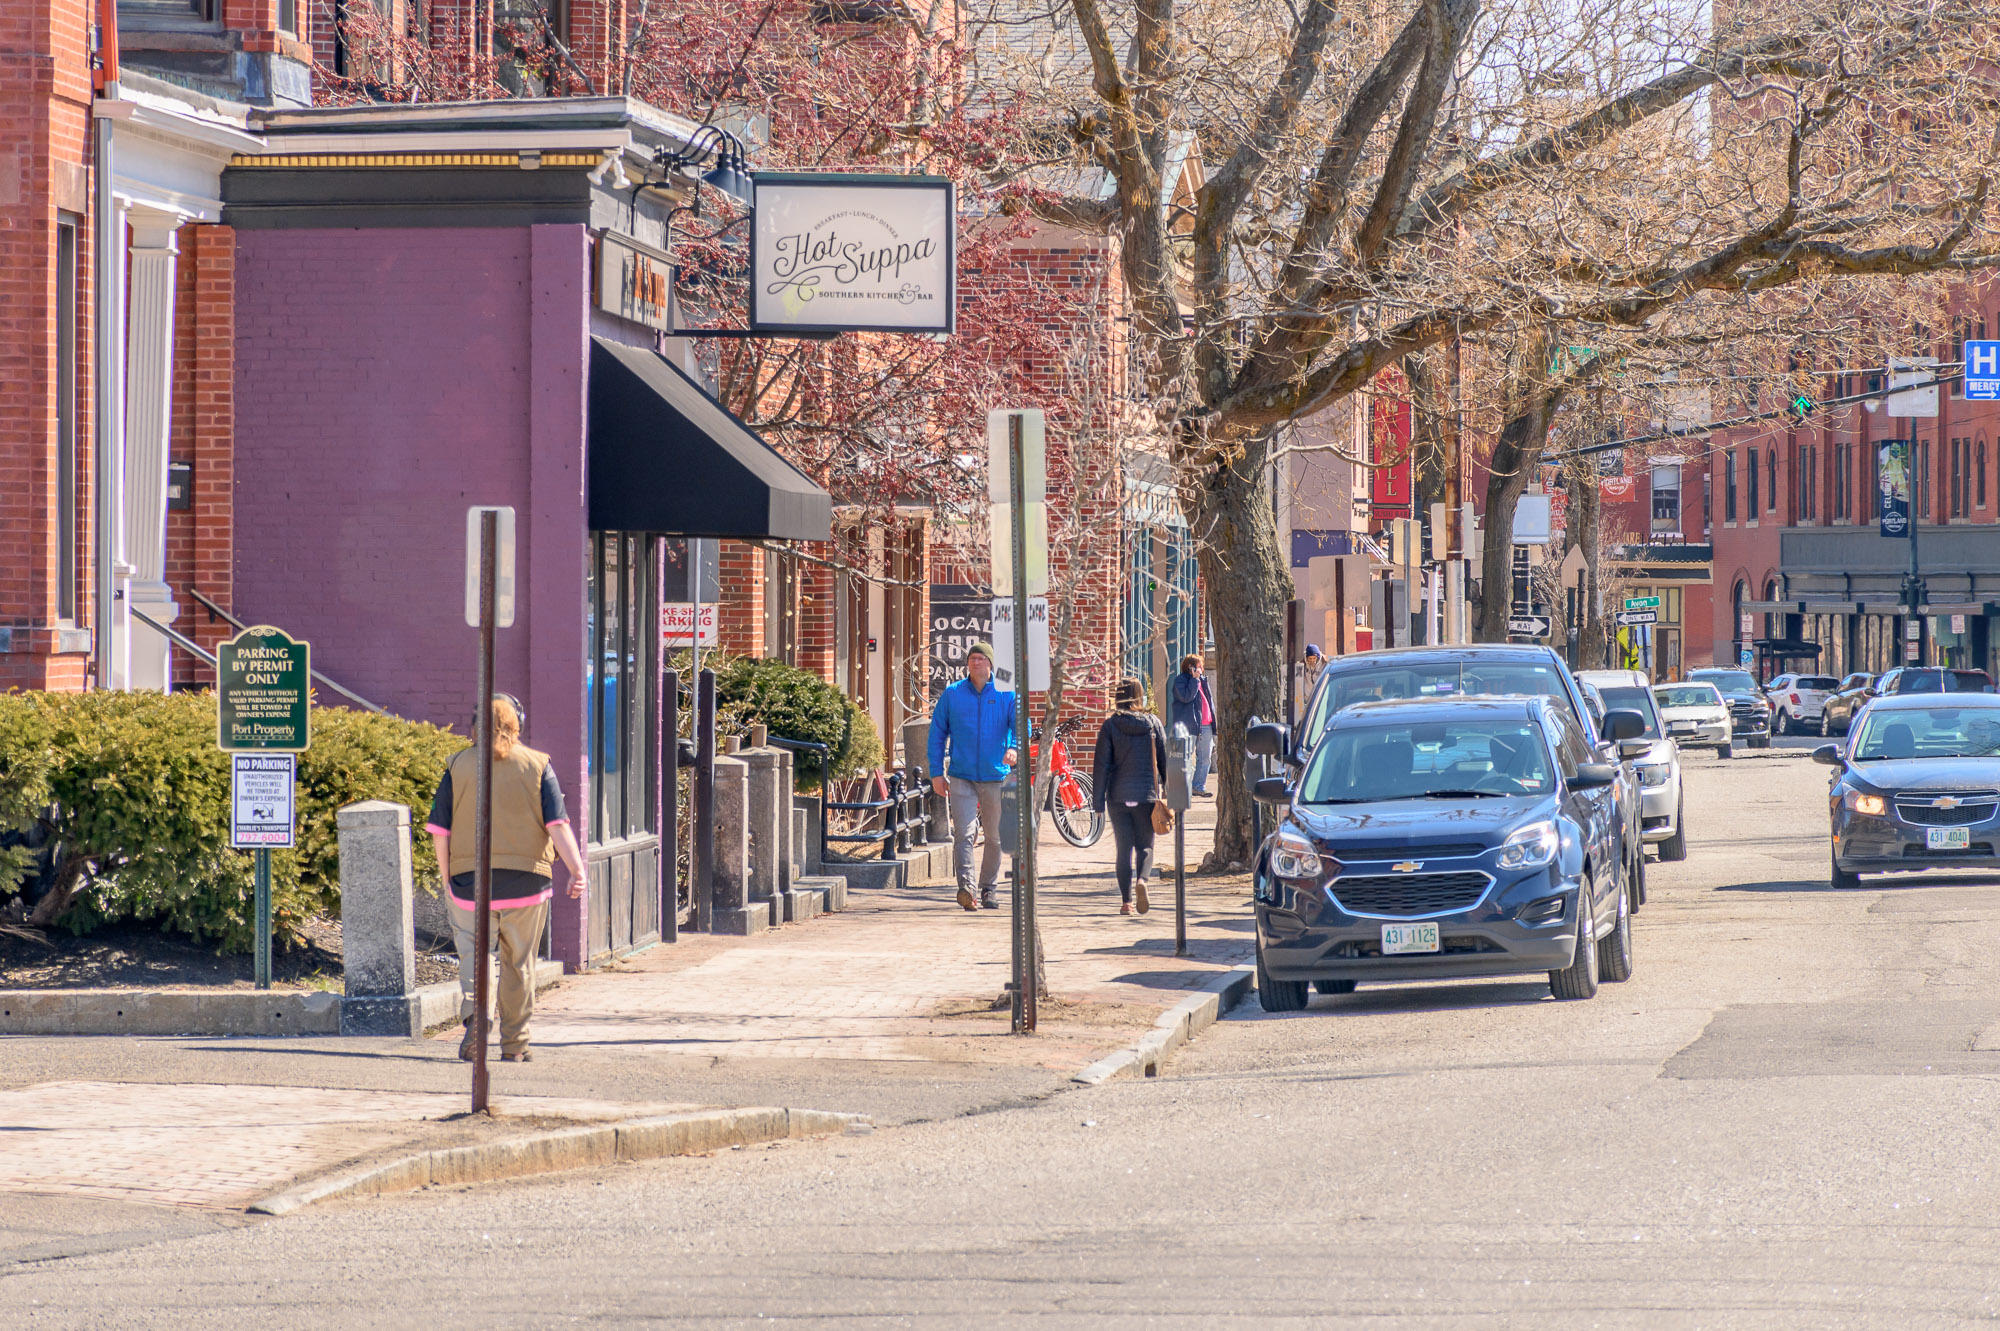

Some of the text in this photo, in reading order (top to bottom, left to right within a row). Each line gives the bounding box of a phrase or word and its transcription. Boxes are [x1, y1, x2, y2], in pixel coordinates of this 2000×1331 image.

[814, 210, 898, 239] BREAKFAST LUNCH DINNER
[774, 231, 937, 284] Hot Suppa
[819, 291, 864, 299] SOUTHERN
[867, 292, 904, 300] KITCHEN
[898, 282, 920, 305] &
[1974, 346, 1996, 374] H
[1970, 382, 2000, 391] MERCY
[1631, 600, 1647, 608] Avon
[237, 648, 289, 659] PARKING
[232, 660, 294, 671] BY PERMIT
[245, 673, 280, 684] ONLY
[232, 723, 295, 736] Port Property
[237, 759, 290, 769] NO PARKING
[1930, 832, 1943, 842] 431
[1385, 928, 1436, 944] 431 1125
